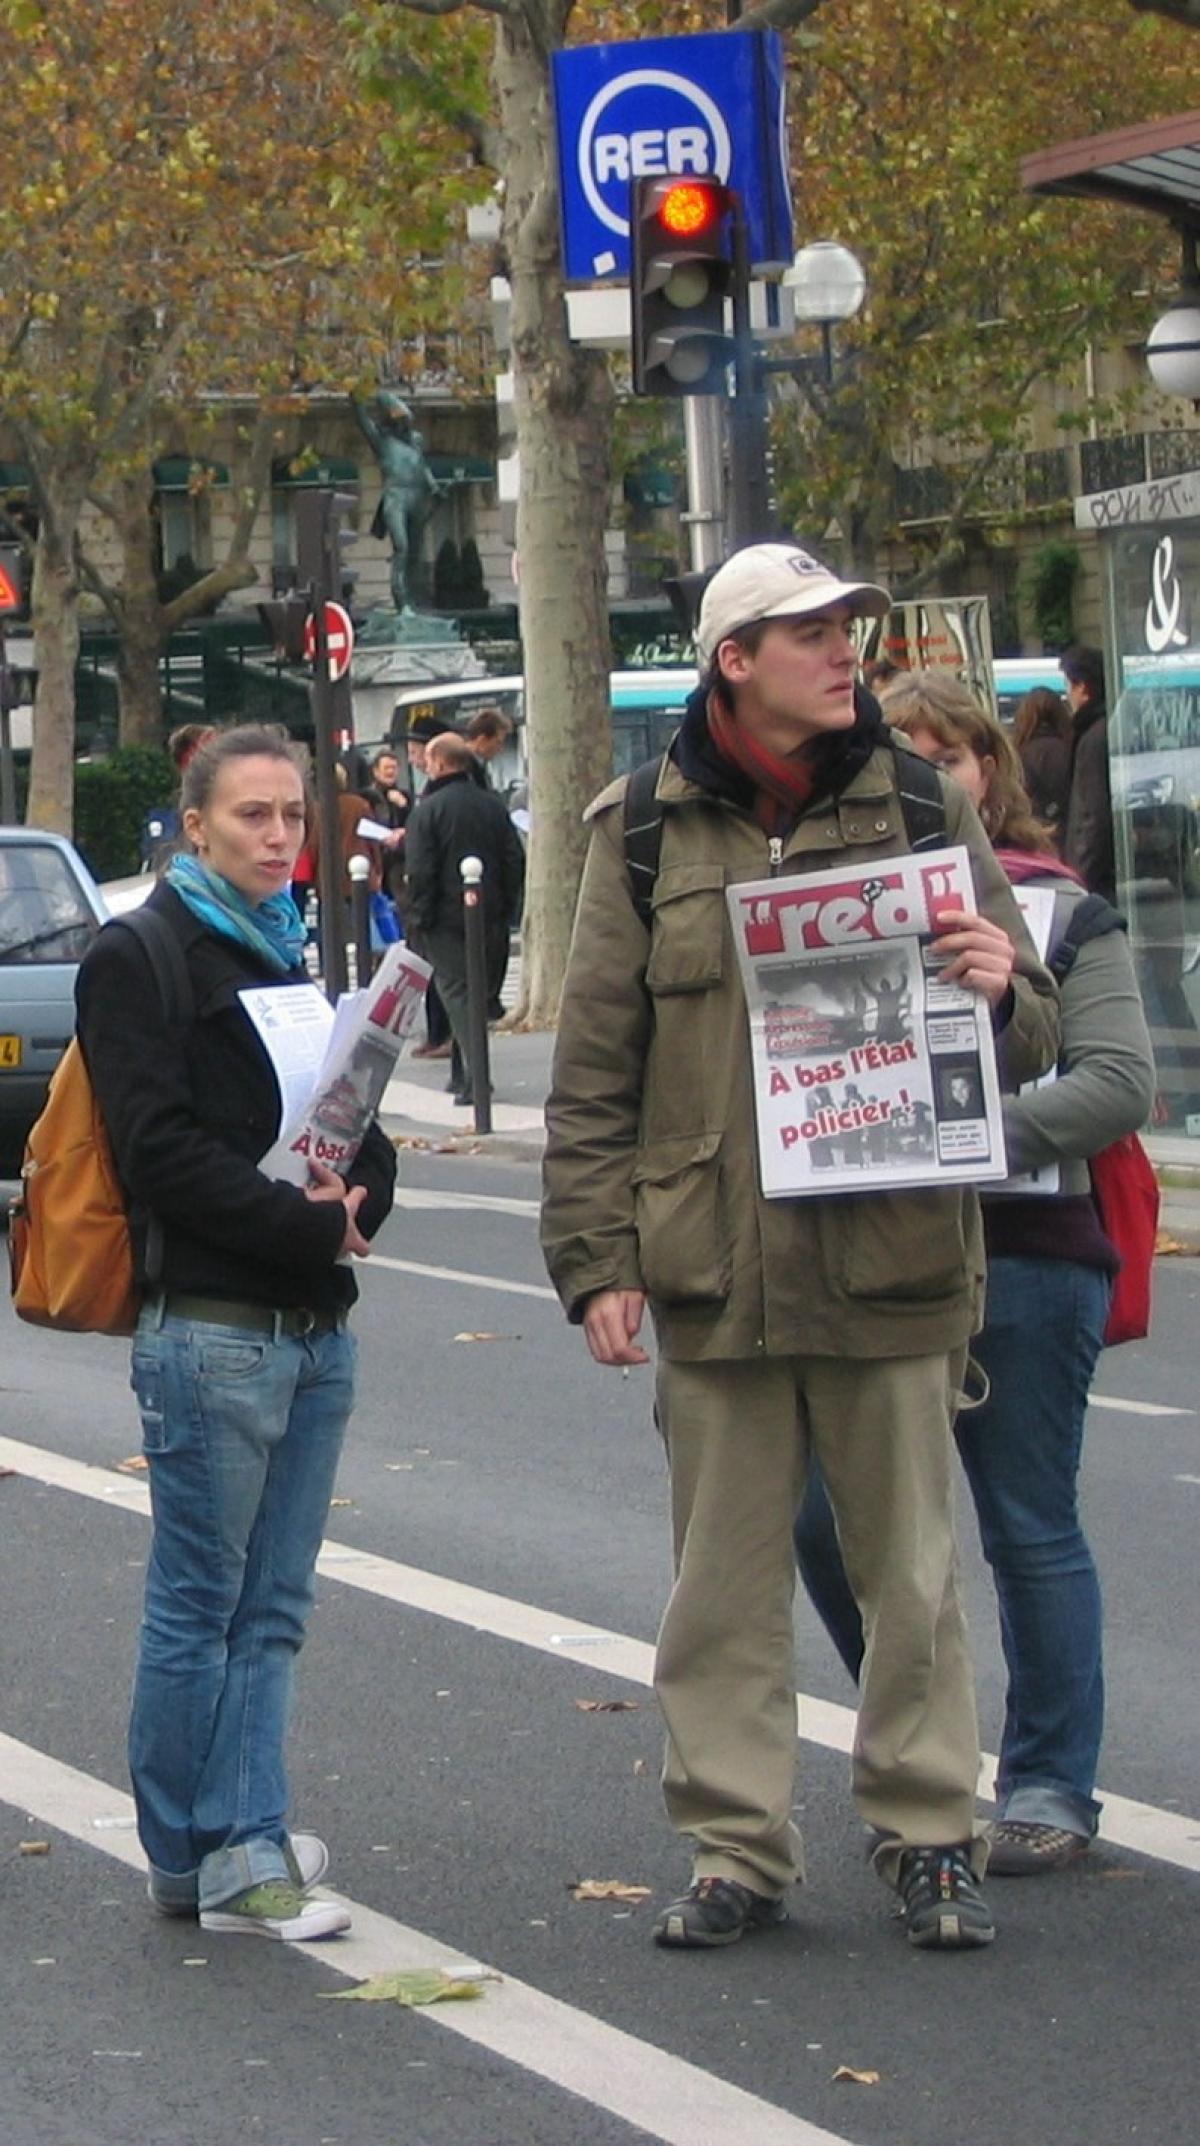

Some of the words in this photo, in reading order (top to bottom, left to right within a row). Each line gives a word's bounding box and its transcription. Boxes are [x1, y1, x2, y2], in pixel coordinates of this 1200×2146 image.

[594, 126, 709, 183] RER
[794, 1060, 846, 1088] bas
[850, 1038, 918, 1074] l'État
[314, 1136, 346, 1161] bas
[780, 1099, 891, 1150] policier
